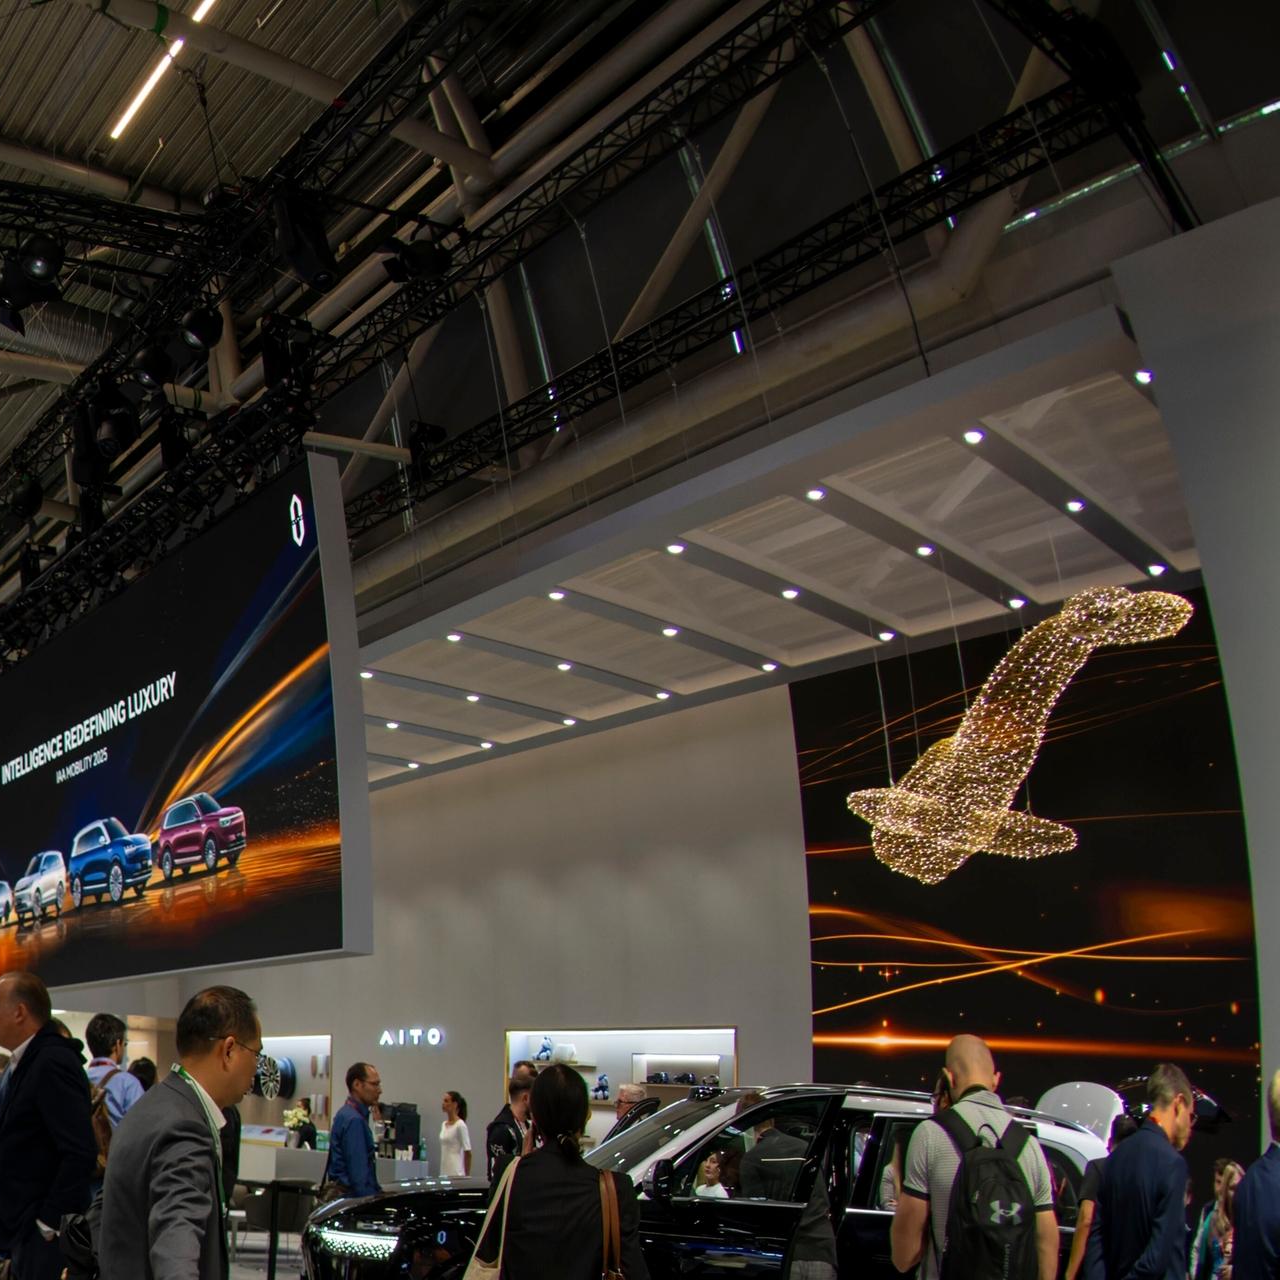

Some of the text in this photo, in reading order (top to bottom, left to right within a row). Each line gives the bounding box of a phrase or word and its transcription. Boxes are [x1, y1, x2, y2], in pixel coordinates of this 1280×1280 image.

[1, 671, 177, 785] INTELLIGENCE REDEFINING LUXURY
[65, 757, 92, 777] MOBILITY
[92, 747, 108, 766] 2025
[379, 1028, 441, 1046] AITO
